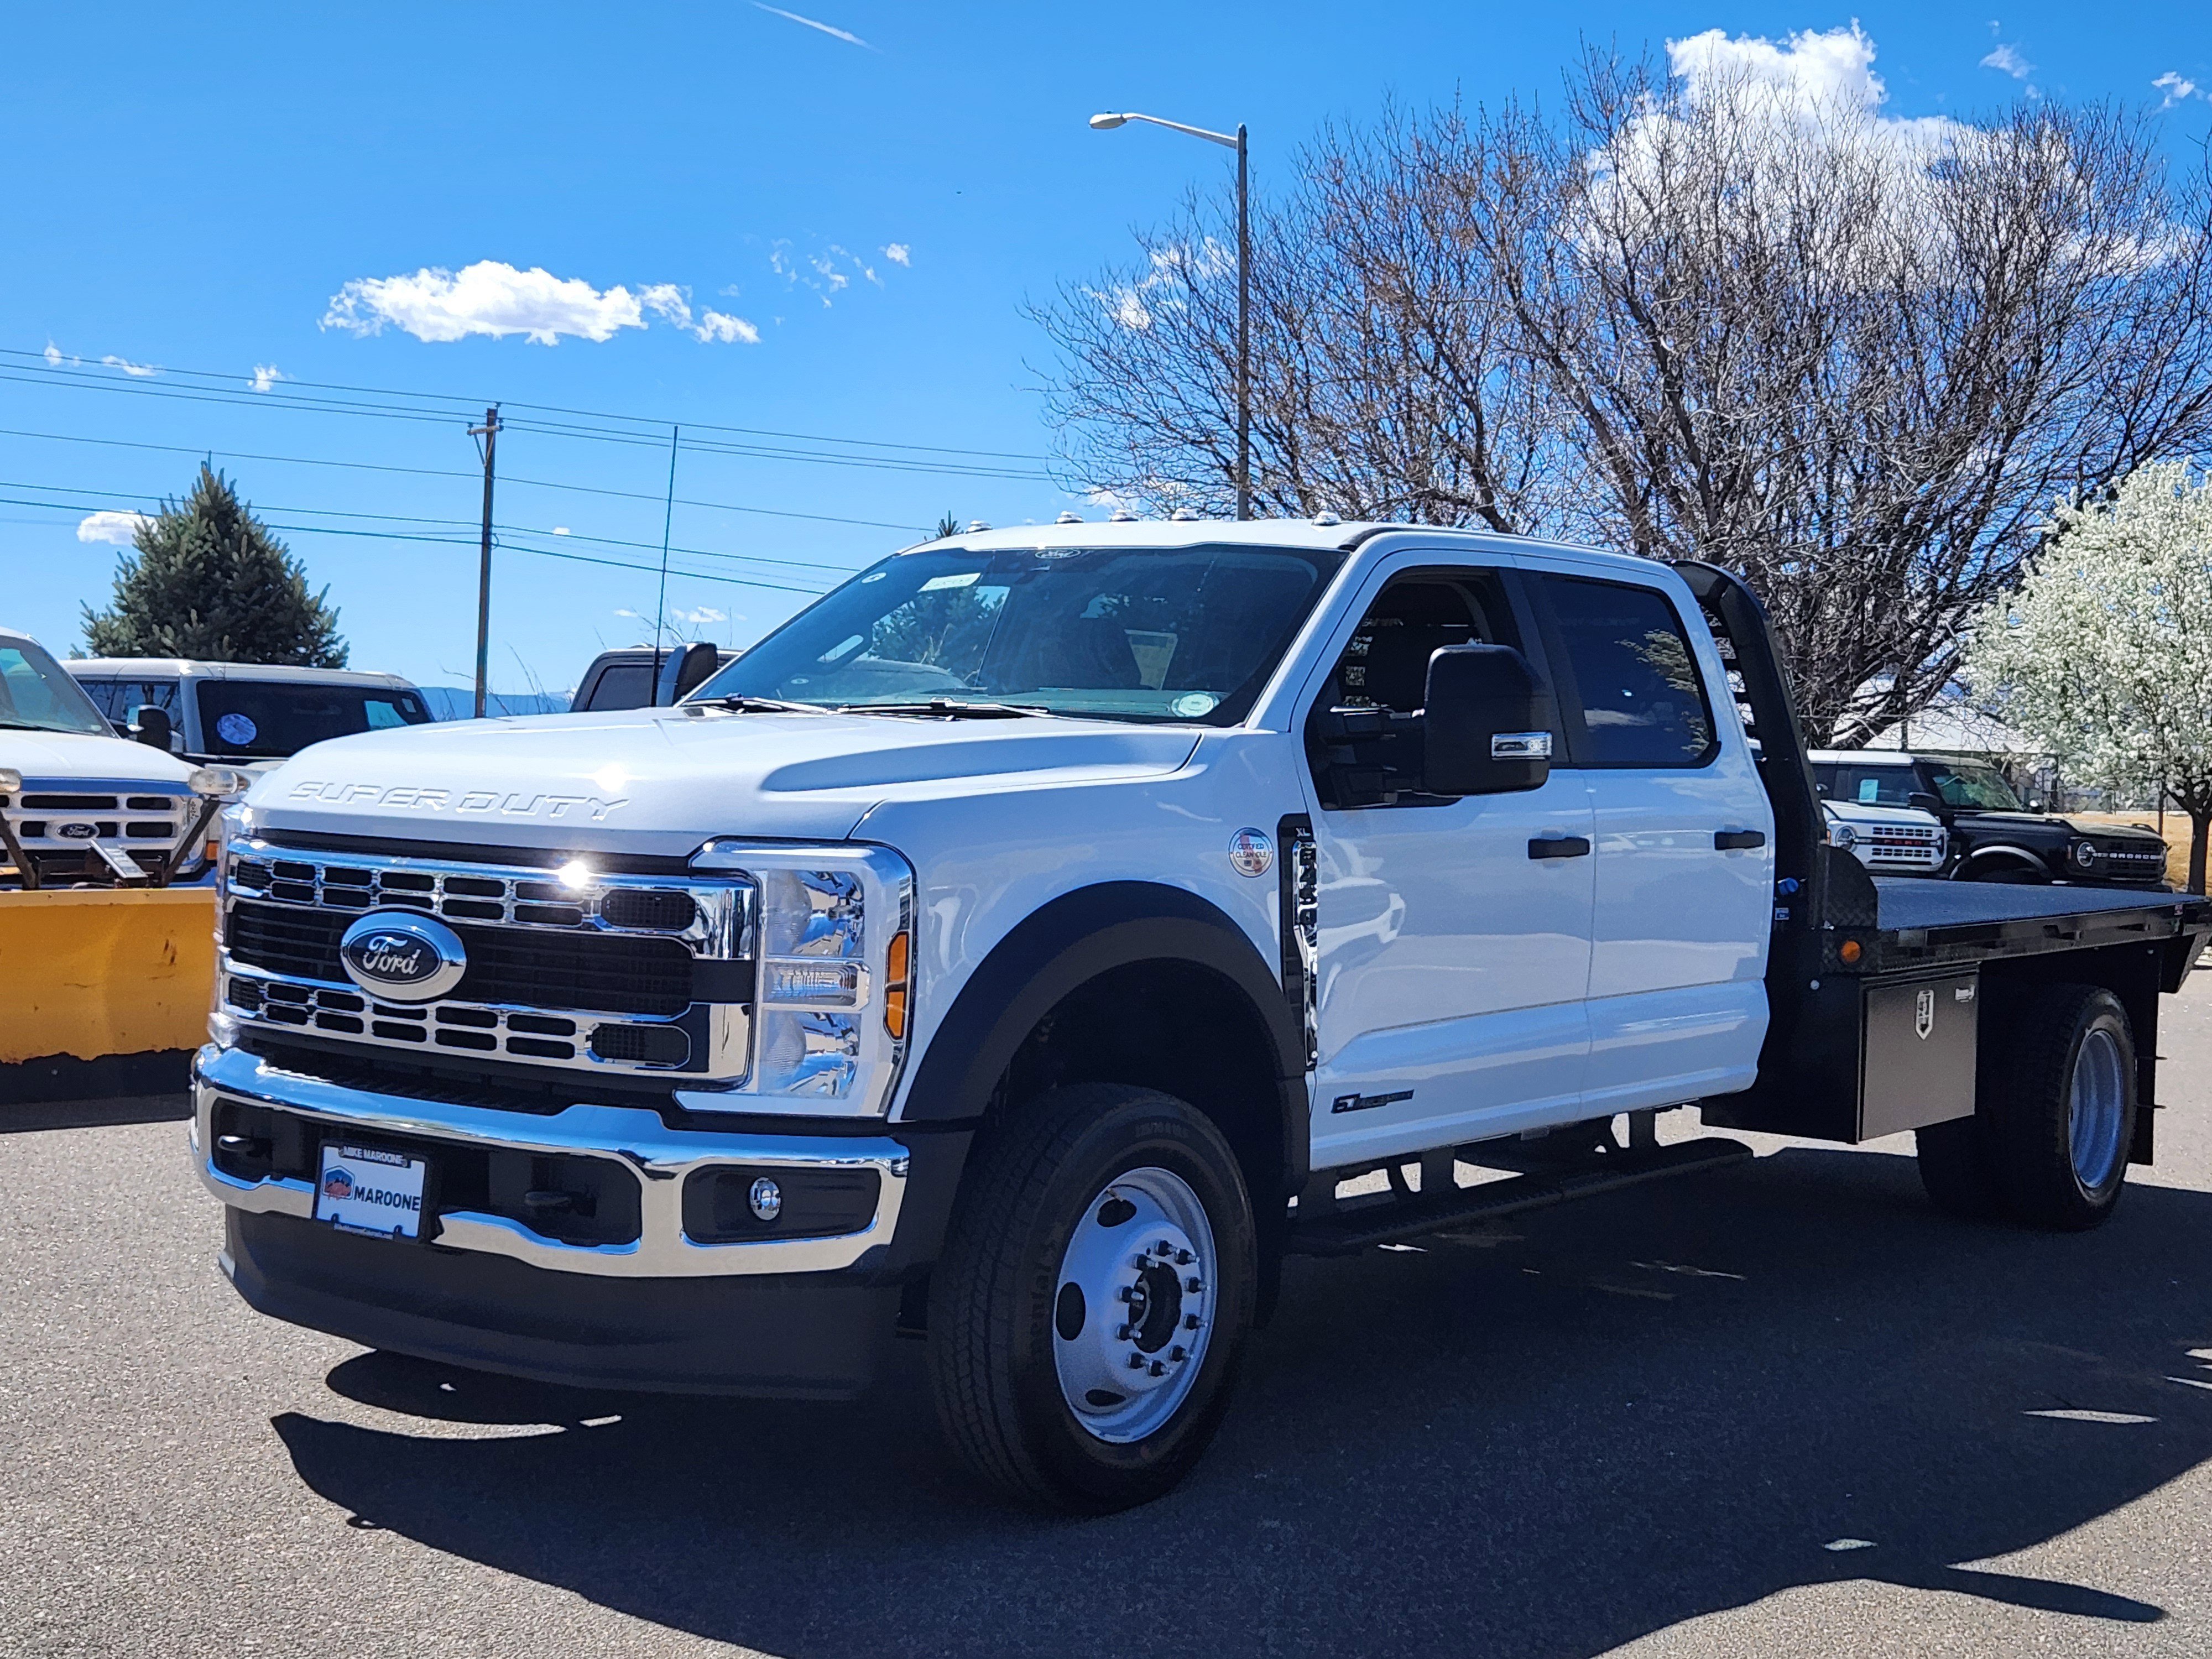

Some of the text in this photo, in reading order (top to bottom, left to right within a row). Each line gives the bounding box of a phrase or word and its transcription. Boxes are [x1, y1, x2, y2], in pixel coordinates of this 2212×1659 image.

[288, 781, 630, 821] SUPER DUTY
[67, 826, 90, 836] Ford
[1296, 827, 1311, 837] XL
[362, 935, 422, 975] Ford
[343, 1146, 404, 1165] MIKE MAROONE
[353, 1186, 421, 1212] MAROONE
